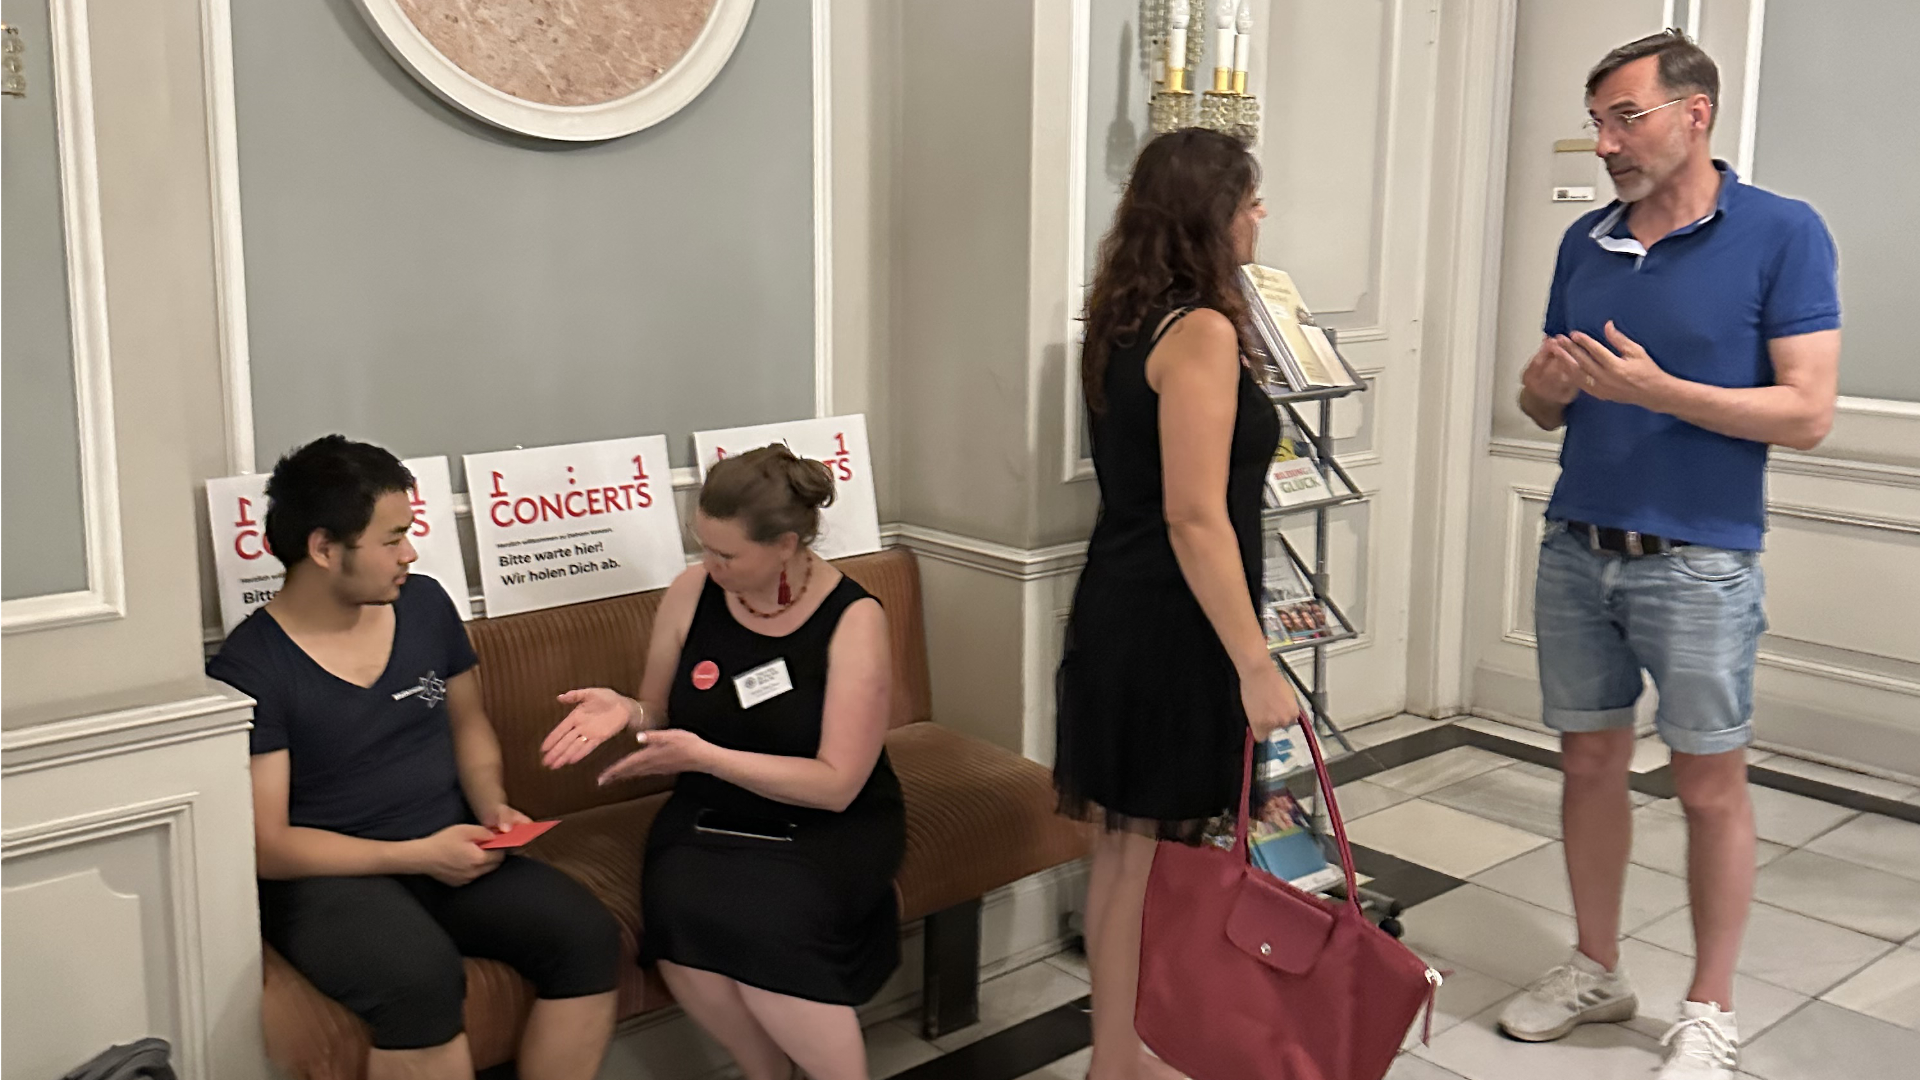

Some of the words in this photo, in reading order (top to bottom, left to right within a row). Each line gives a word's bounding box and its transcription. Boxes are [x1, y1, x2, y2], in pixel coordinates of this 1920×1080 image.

[833, 431, 850, 456] 1
[631, 454, 649, 481] 1
[490, 482, 653, 528] CONCERTS
[499, 554, 532, 567] Bitte
[534, 548, 572, 562] warte
[574, 541, 604, 556] hier!
[501, 572, 526, 586] Wir
[528, 567, 567, 582] holen
[569, 560, 599, 575] Dich
[601, 558, 621, 570] ab.
